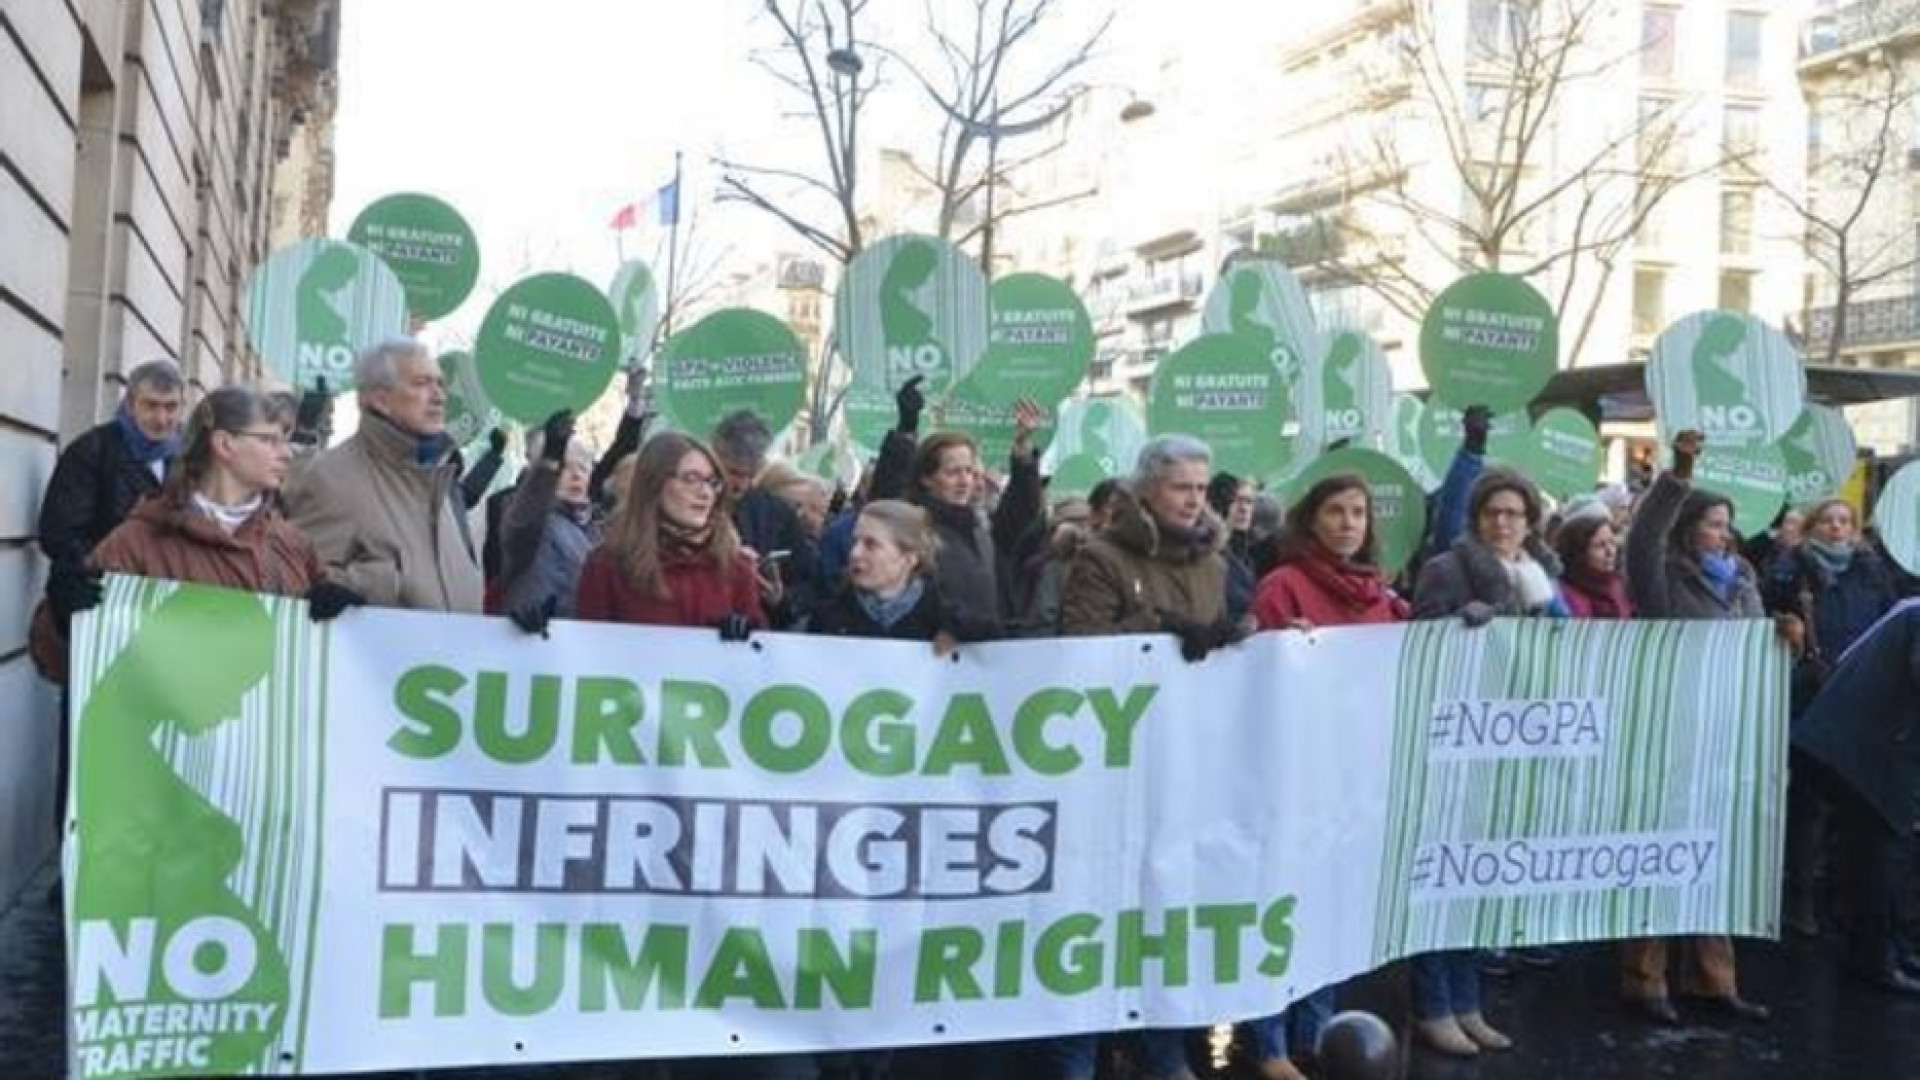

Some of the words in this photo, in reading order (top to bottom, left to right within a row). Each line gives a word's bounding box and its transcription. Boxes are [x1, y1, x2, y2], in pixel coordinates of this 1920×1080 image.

[508, 304, 525, 320] NI
[530, 309, 608, 343] GRATUITE
[1003, 308, 1076, 323] GRATUITE
[1465, 308, 1543, 330] GRATUITE
[300, 342, 354, 368] NO
[504, 324, 525, 342] NI
[526, 328, 601, 360] PAYANTE
[888, 343, 944, 372] NO
[1270, 347, 1290, 370] O
[1174, 374, 1192, 388] NI
[1195, 374, 1269, 389] GRATUITE
[1176, 394, 1193, 408] NI
[1197, 394, 1267, 410] PAYANTE
[1325, 408, 1362, 429] NO
[1701, 404, 1757, 431] NO
[1787, 471, 1827, 499] NO
[386, 664, 1160, 778] SURROGACY
[1428, 700, 1601, 747] #NoGPA
[383, 792, 1053, 897] INFRINGES
[1410, 839, 1716, 888] #NoSurrogacy
[74, 915, 258, 1006] NO
[378, 921, 879, 1018] HUMAN
[914, 895, 1298, 1002] RIGHTS
